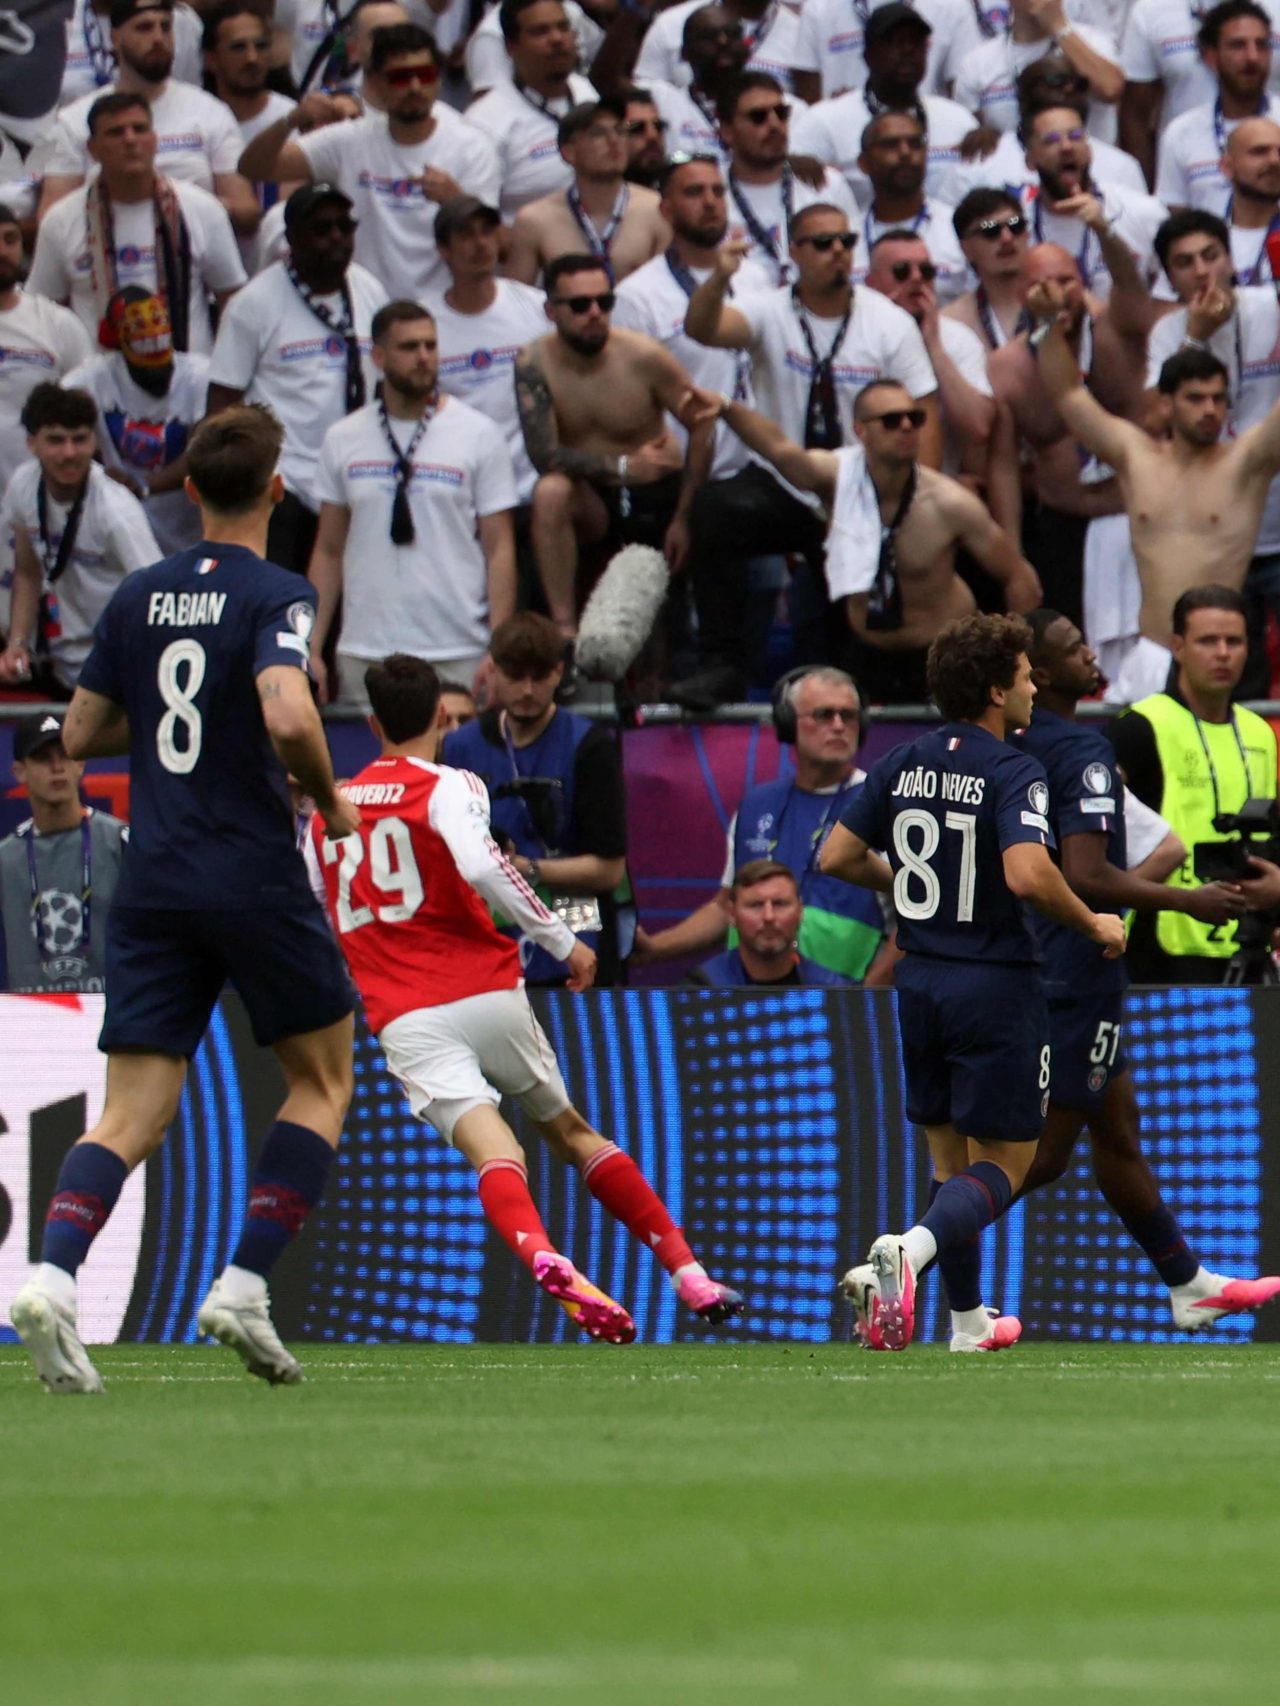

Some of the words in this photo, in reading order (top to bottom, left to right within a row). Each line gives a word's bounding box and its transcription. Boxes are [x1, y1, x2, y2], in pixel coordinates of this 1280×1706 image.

[147, 591, 227, 627] FABIAN
[156, 637, 207, 775] 8
[892, 766, 938, 799] JOÃO
[941, 771, 986, 806] NEVES
[322, 816, 425, 934] 29
[892, 808, 978, 924] 87
[1090, 1020, 1120, 1067] 51
